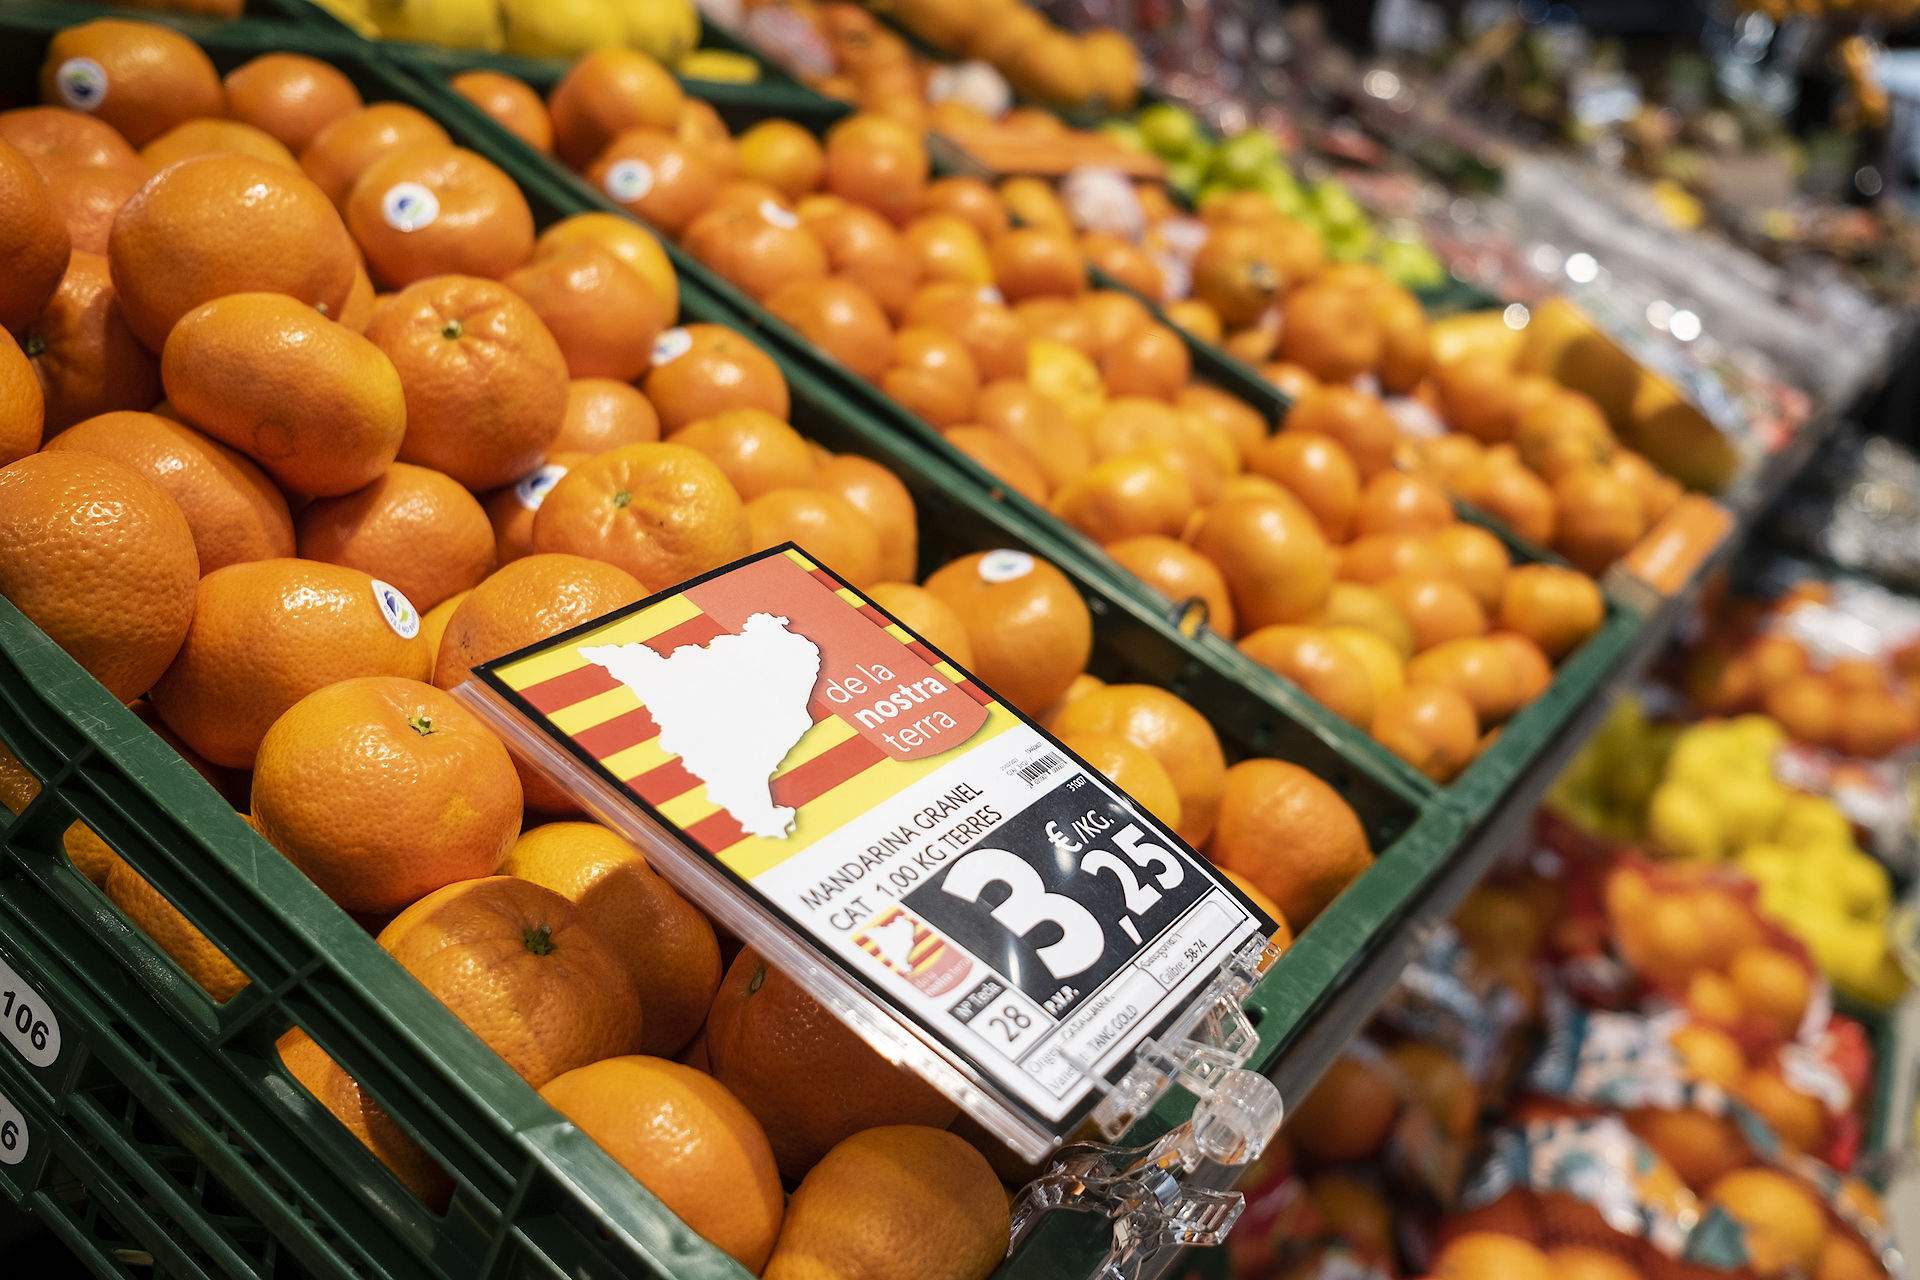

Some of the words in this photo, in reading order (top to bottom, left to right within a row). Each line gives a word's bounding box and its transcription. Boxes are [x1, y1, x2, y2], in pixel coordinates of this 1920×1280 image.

[826, 678, 868, 703] de
[855, 664, 896, 685] la
[853, 677, 948, 730] nostra
[881, 711, 957, 752] terra
[1066, 775, 1087, 792] 31007
[800, 825, 921, 911] MANDARINA
[913, 782, 984, 830] GRANEL
[830, 896, 873, 931] CAT
[875, 864, 919, 897] 1,00
[911, 844, 947, 871] KG
[938, 804, 1003, 850] TERRES
[1183, 938, 1208, 963] 58-74
[3, 990, 50, 1051] 106
[988, 1006, 1031, 1042] 28
[0, 1120, 19, 1150] 6
